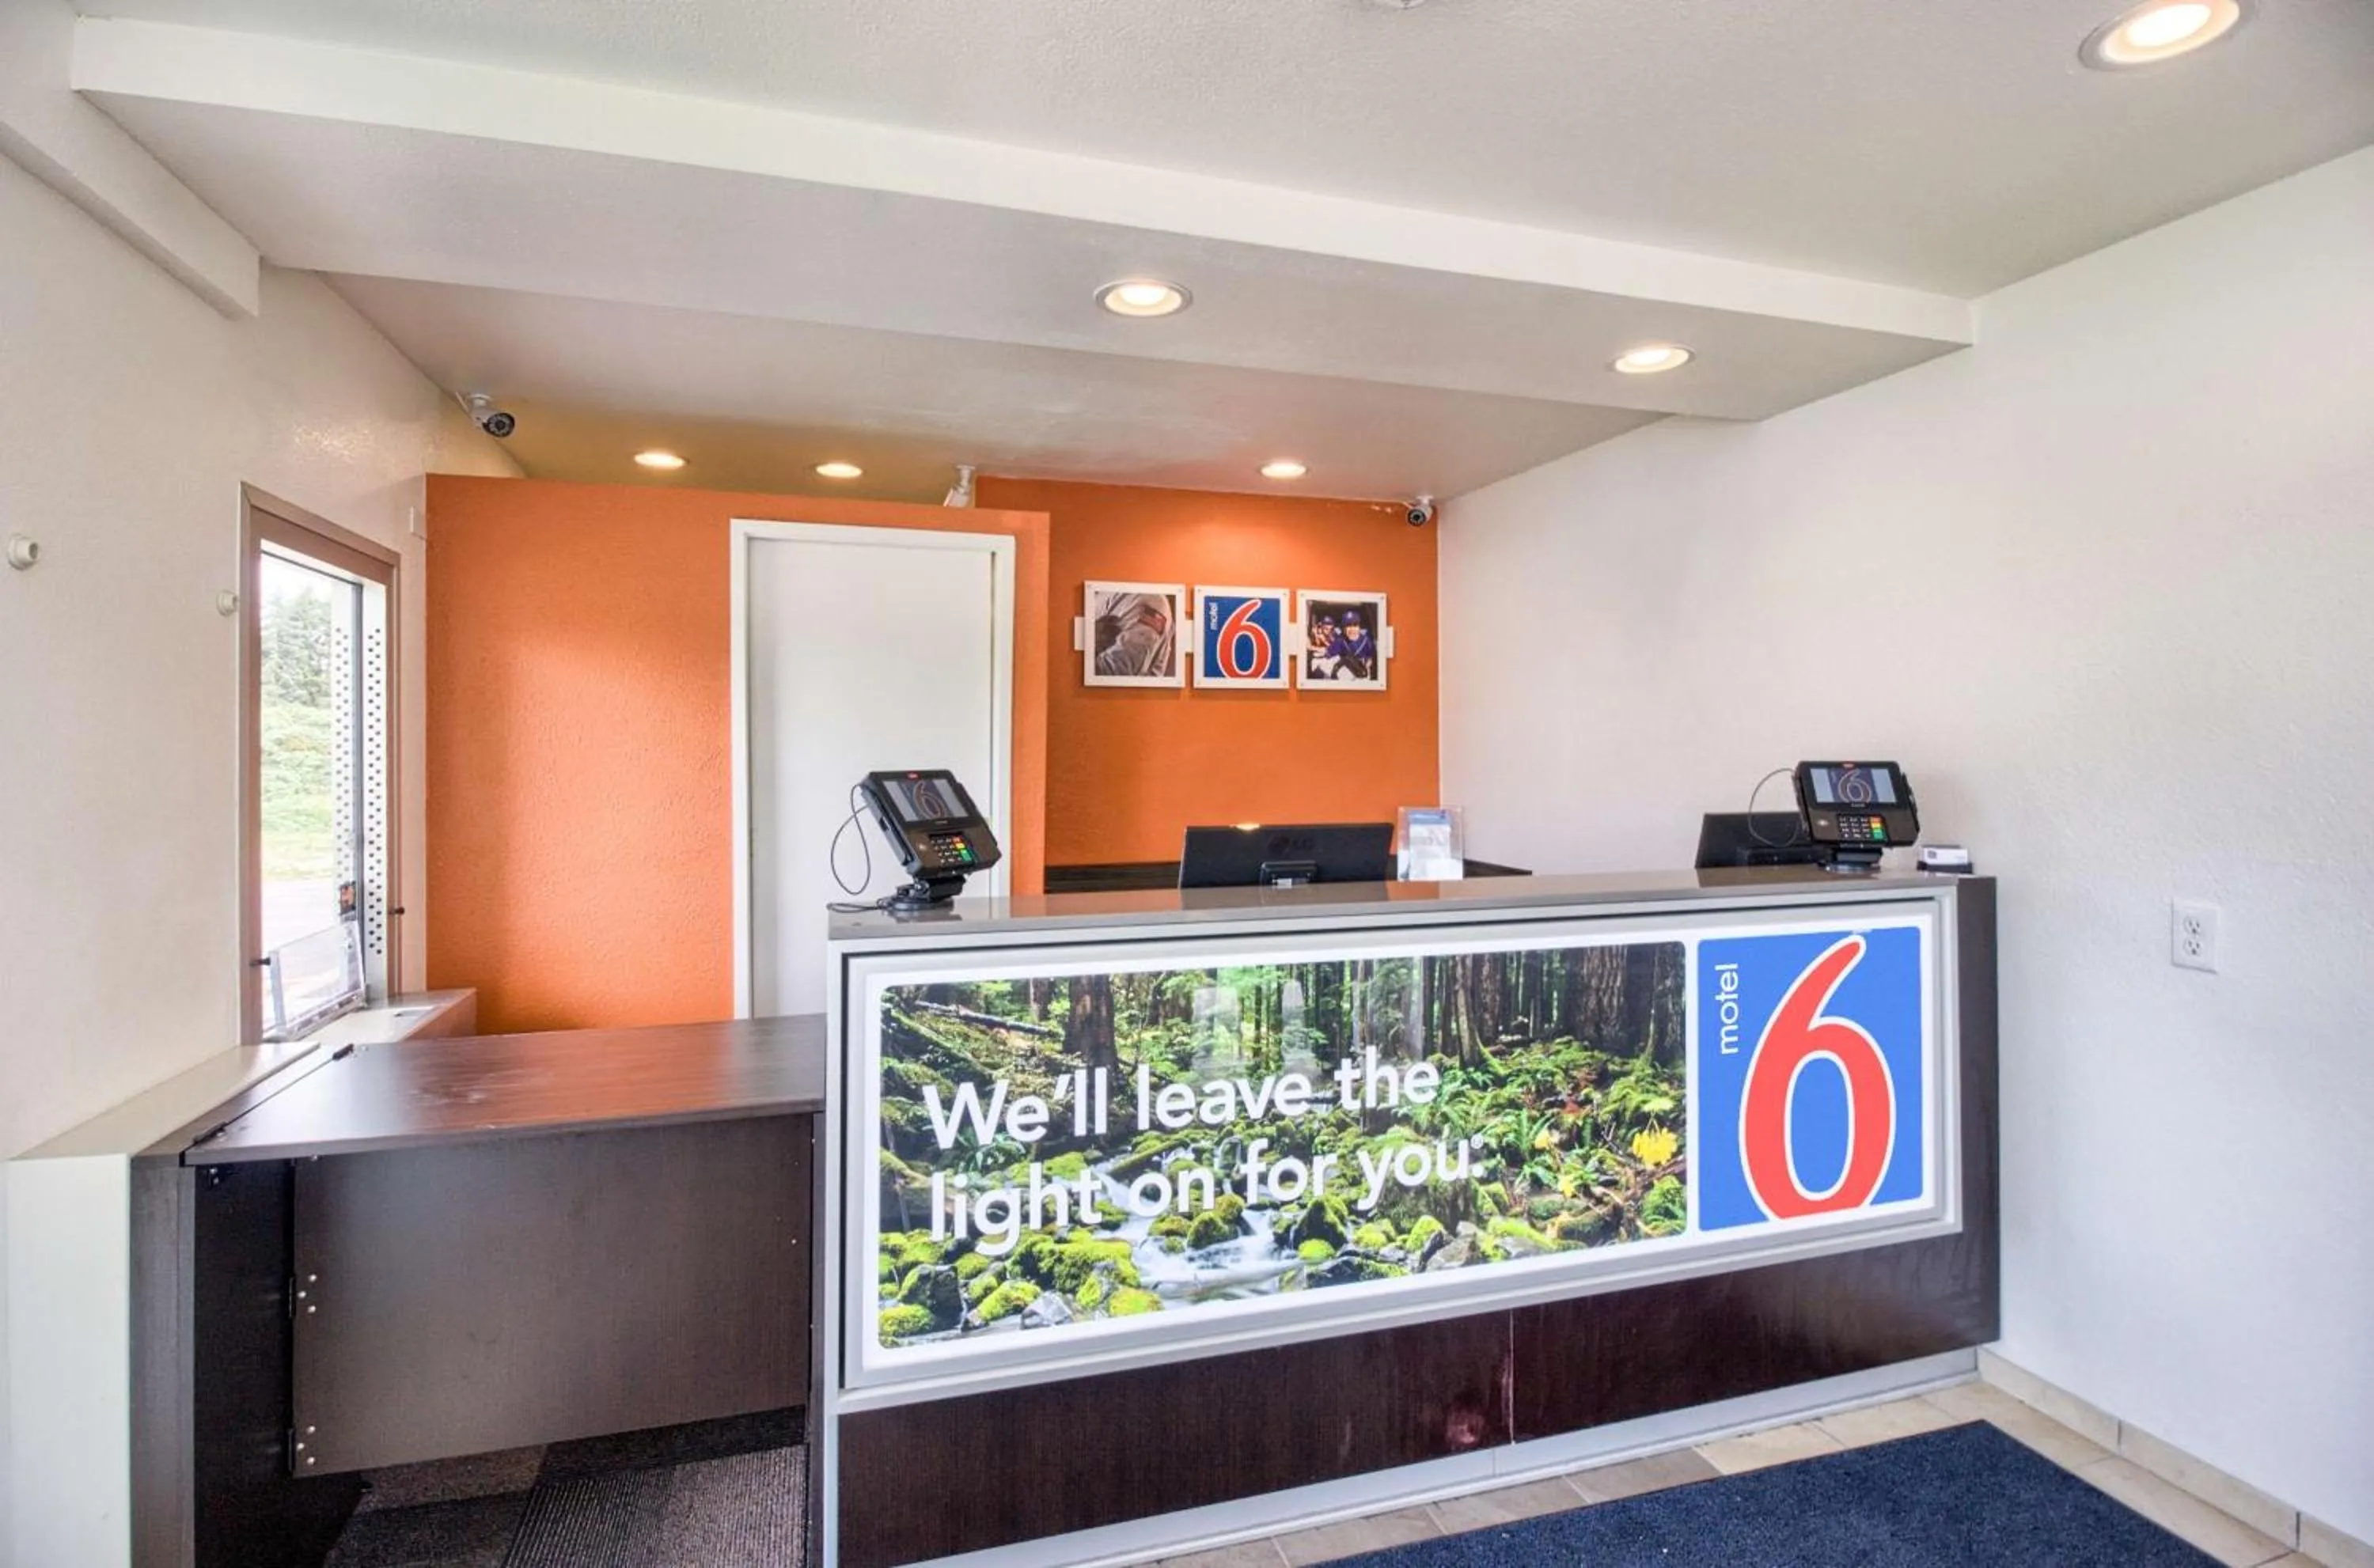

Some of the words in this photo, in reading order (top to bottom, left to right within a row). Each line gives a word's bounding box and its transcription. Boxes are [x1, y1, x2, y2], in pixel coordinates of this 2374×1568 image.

[1216, 599, 1272, 680] 6
[1715, 963, 1739, 1056] motel
[922, 1067, 1108, 1149] We'll
[1137, 1063, 1313, 1131] leave
[1333, 1044, 1440, 1111] the
[1739, 934, 1897, 1222] 6
[931, 1161, 1103, 1256] light
[1128, 1168, 1215, 1218] on
[1239, 1138, 1337, 1204] for
